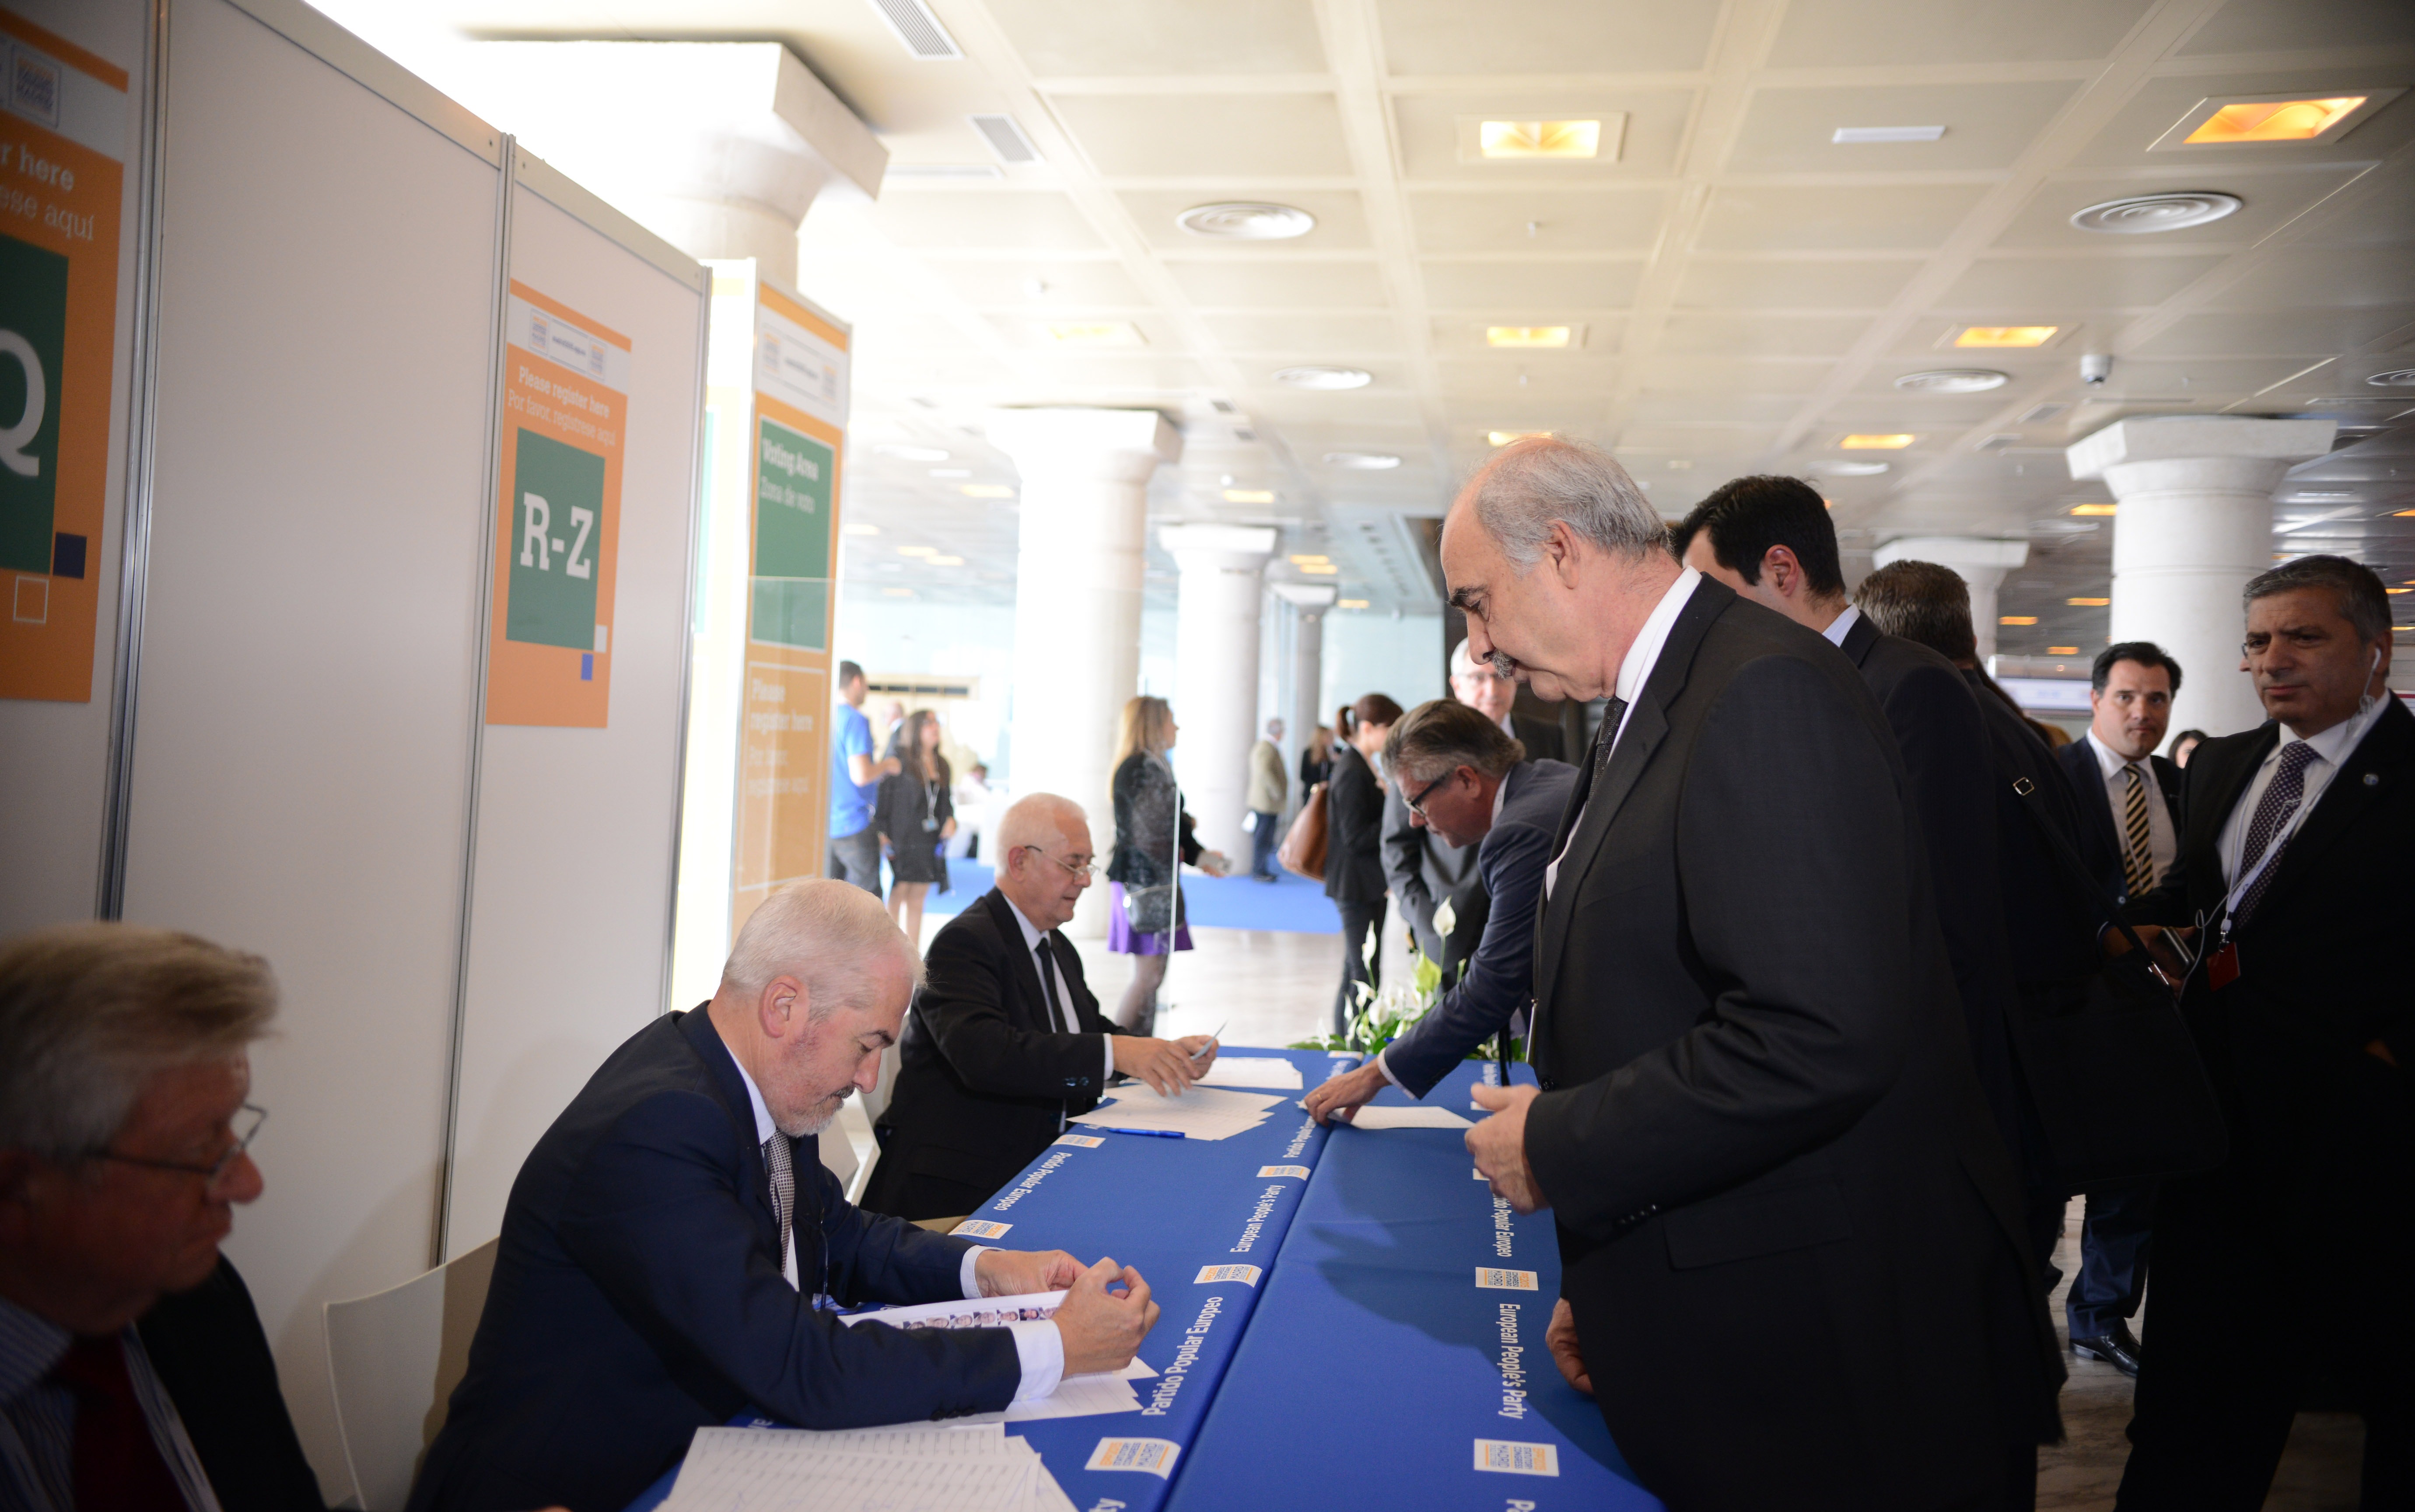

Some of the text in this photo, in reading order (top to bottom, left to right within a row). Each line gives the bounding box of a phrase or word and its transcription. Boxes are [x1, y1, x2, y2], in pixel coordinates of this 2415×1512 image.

[19, 143, 74, 191] here
[45, 203, 94, 240] aquí
[508, 388, 525, 412] Por
[519, 365, 610, 419] Please register here
[763, 438, 819, 482] Voting Area
[520, 492, 593, 580] R-Z
[993, 1152, 1072, 1211] Partido Popular Europeo
[1260, 1185, 1286, 1198] Party
[1246, 1199, 1275, 1222] People's
[1491, 1209, 1514, 1231] Popular
[1229, 1223, 1263, 1252] European
[1492, 1232, 1514, 1257] Europeo
[1229, 1266, 1244, 1279] MADRID
[1494, 1270, 1503, 1286] MADRID
[1141, 1376, 1184, 1415] Partido
[1164, 1336, 1204, 1374] Popular
[1185, 1296, 1223, 1334] Europeo
[1496, 1303, 1527, 1419] European People's Party
[1136, 1443, 1157, 1466] MADRID
[1497, 1445, 1509, 1468] MADRID
[1513, 1446, 1523, 1469] CONGRESS
[1523, 1447, 1533, 1469] STATUTORY
[1506, 1498, 1535, 1512] P
